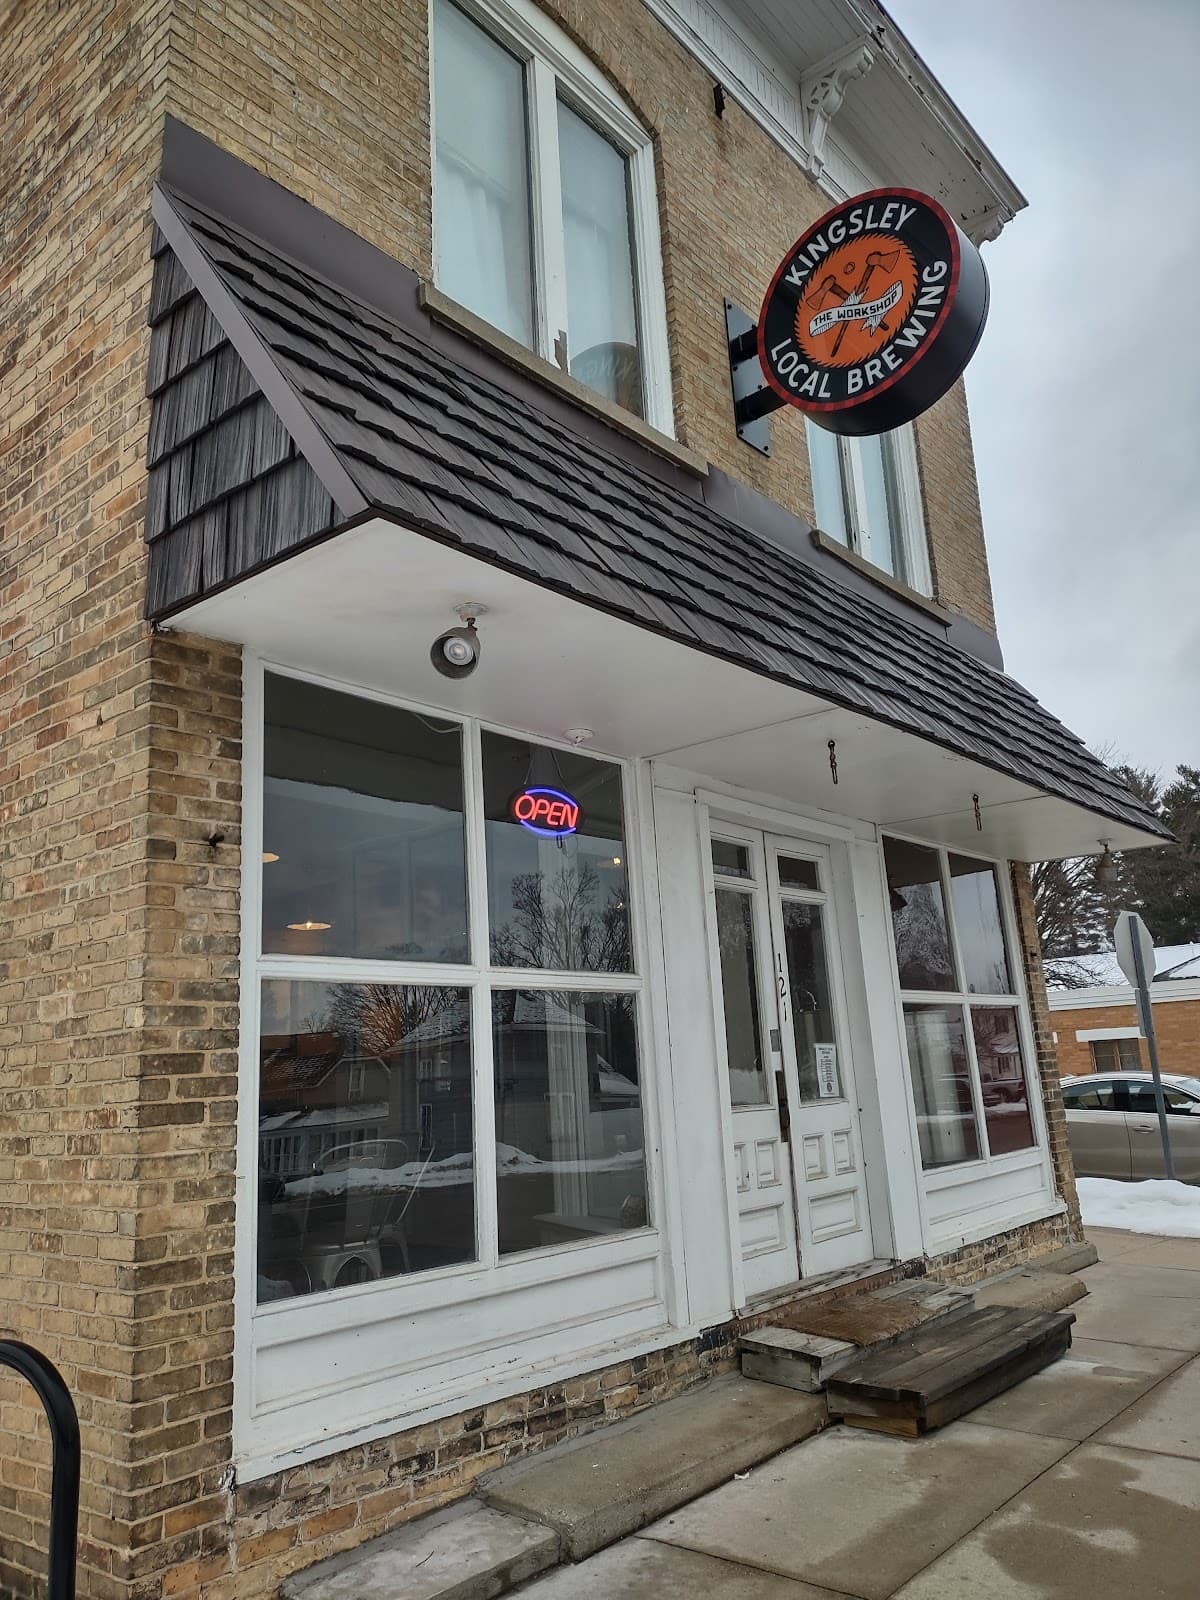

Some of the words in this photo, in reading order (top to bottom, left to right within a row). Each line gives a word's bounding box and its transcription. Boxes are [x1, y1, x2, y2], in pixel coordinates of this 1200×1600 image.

[784, 202, 917, 287] KINGSLEY
[771, 337, 832, 398] LOCAL
[847, 260, 948, 394] BREWING
[813, 311, 833, 326] THE
[837, 290, 897, 319] WORKSHOP
[515, 795, 579, 828] OPEN
[778, 953, 788, 1022] 121
